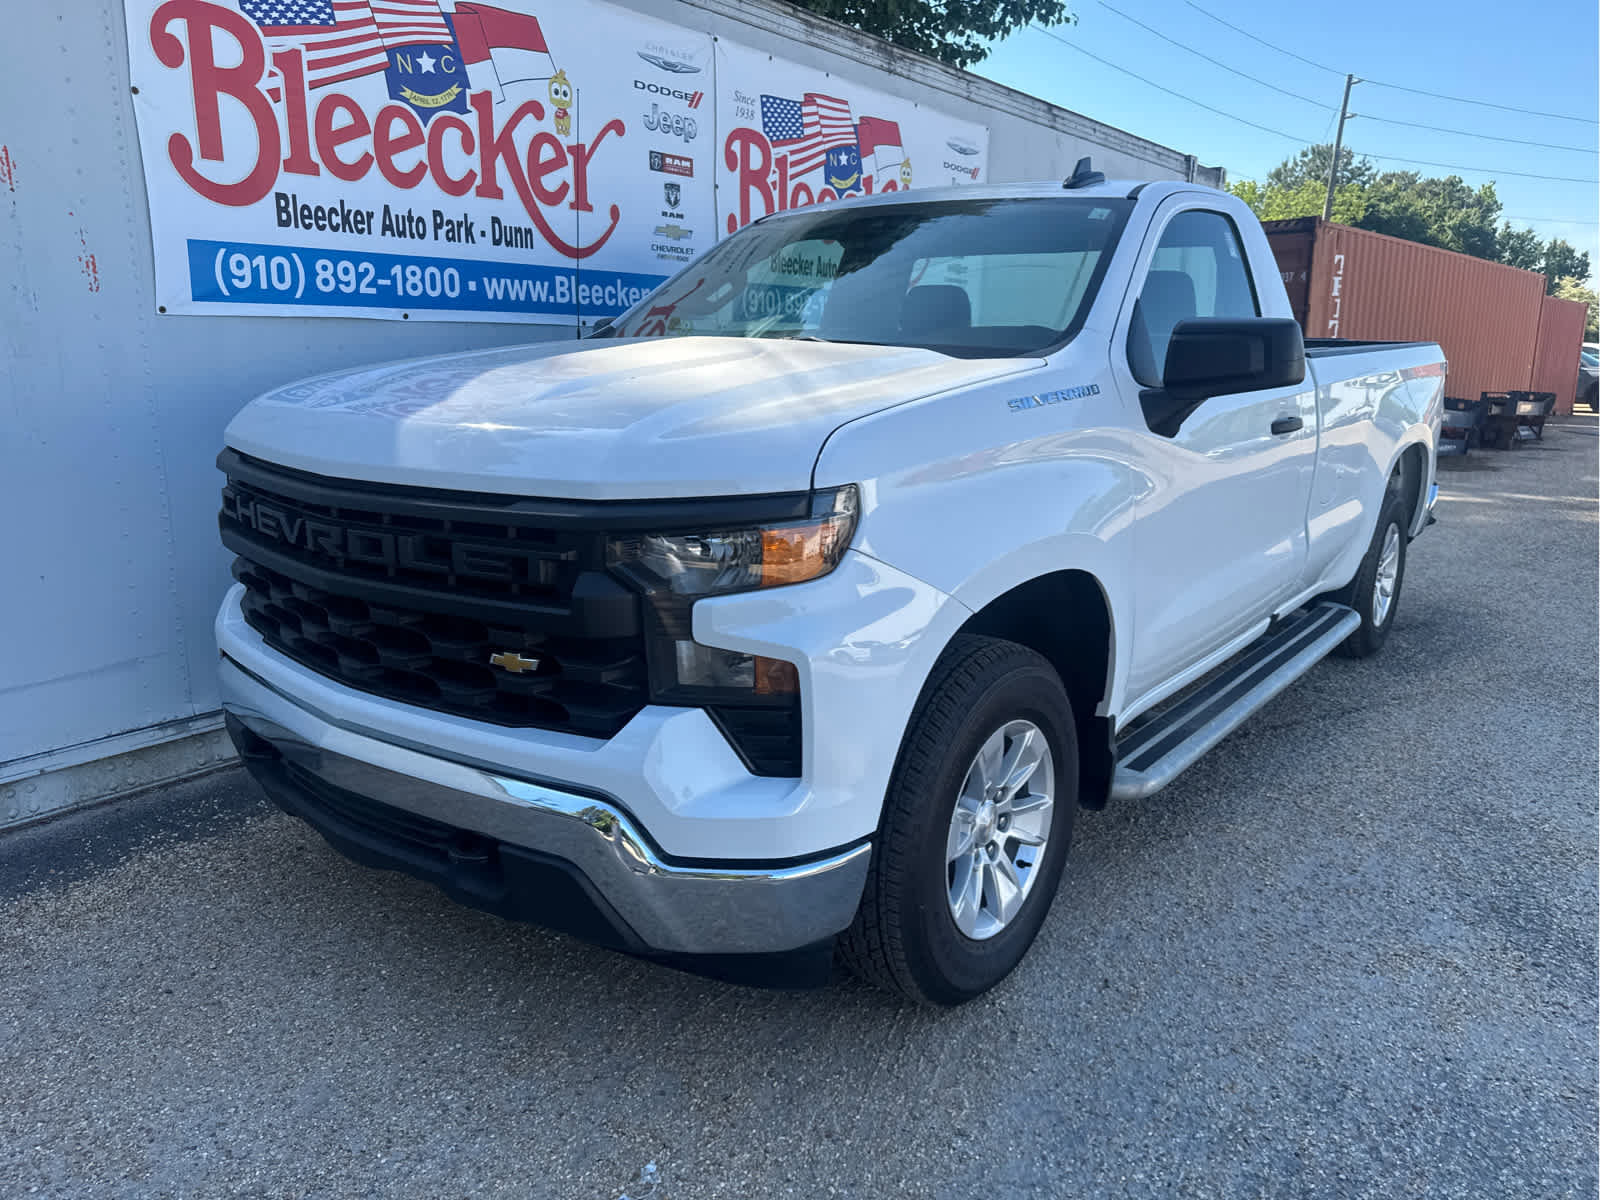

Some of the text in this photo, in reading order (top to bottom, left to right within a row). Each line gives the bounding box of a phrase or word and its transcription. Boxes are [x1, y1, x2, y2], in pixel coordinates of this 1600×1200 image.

[396, 53, 456, 74] N C
[634, 80, 695, 102] DODGE
[733, 89, 756, 106] Since
[150, 2, 625, 259] Bleecker
[643, 102, 697, 143] Jeep
[665, 157, 691, 169] RAM
[275, 191, 534, 249] Bleecker Auto Park Dunn
[662, 210, 685, 220] RAM
[651, 242, 696, 256] CHEVROLET
[215, 248, 306, 299] (910)
[315, 258, 460, 298] 892-1800
[769, 251, 814, 277] Bleecker
[1008, 384, 1100, 409] SILVERADO
[222, 486, 578, 585] CHEVROLET
